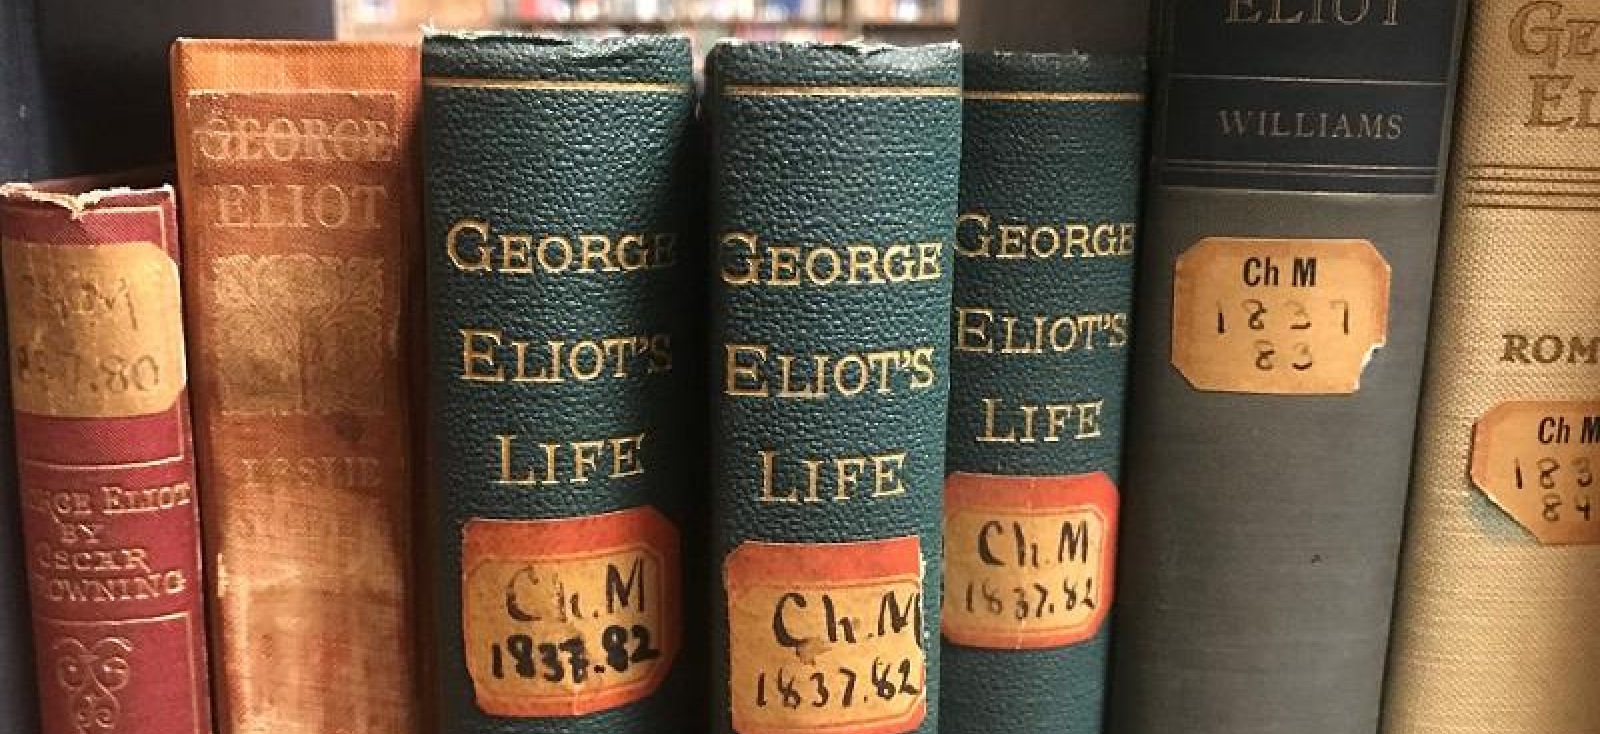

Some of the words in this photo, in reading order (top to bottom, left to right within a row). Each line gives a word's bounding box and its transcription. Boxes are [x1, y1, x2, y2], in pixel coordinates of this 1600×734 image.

[197, 117, 395, 163] GEORGE
[1218, 109, 1404, 140] WILLIAMS
[213, 183, 389, 230] ELIOT
[446, 218, 677, 274] GEORGE
[720, 231, 944, 286] GEORGE
[955, 213, 1136, 259] GEORGE
[1242, 256, 1279, 288] Ch
[1291, 256, 1317, 288] M
[954, 306, 1129, 354] ELIOT'S
[1499, 334, 1600, 364] ROM
[459, 328, 674, 384] ELIOT'S
[725, 344, 937, 398] ELIOT'S
[1253, 338, 1314, 372] 83
[975, 397, 1104, 442] LIFE
[1537, 416, 1571, 445] Ch
[1579, 416, 1600, 445] M
[492, 433, 646, 484] LIFE
[757, 450, 906, 503] LIFE
[101, 482, 191, 515] ELIOT
[60, 523, 101, 543] BY
[35, 569, 187, 602] OWNING
